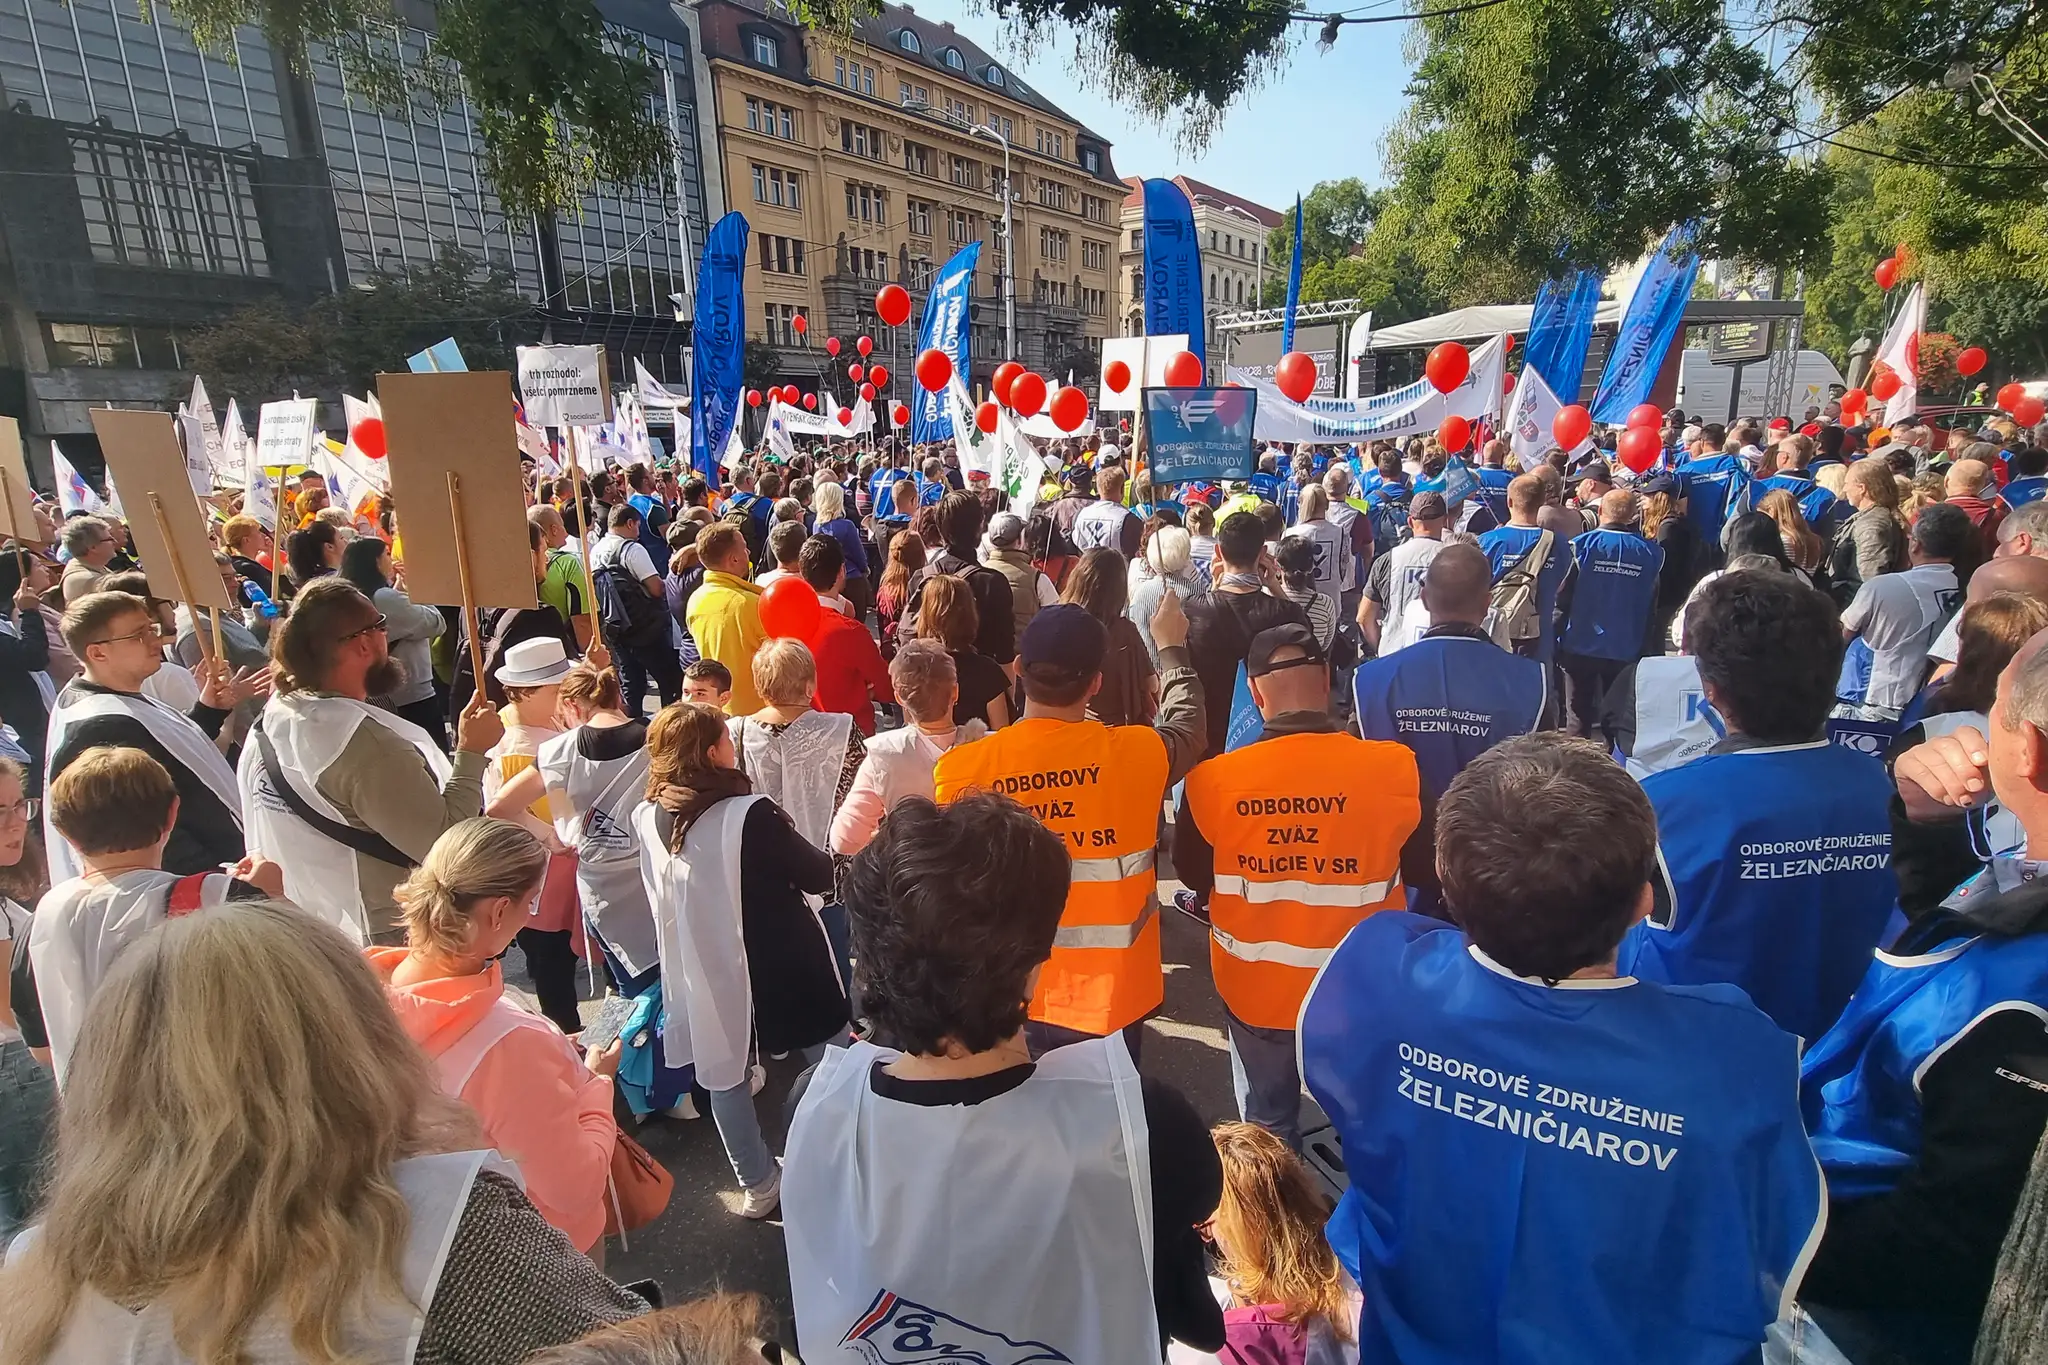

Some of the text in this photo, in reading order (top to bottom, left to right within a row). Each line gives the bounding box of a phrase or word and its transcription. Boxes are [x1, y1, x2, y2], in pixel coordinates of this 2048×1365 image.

[529, 366, 582, 379] trh rozhodol:
[548, 385, 598, 399] pomrzneme
[1395, 706, 1492, 723] ODBOROVÉ RUŽENIE
[1398, 719, 1490, 738] ŽELEZNIAROV
[992, 763, 1100, 795] ODBOROVÝ
[1236, 792, 1347, 817] ODBOROVÝ
[1072, 831, 1085, 847] V
[1091, 828, 1117, 847] SR
[1266, 824, 1319, 845] ZVÄZ
[1740, 833, 1892, 856] ODBOROVÉ ZDRUŽENIE
[1237, 854, 1359, 874] POLÍCIE V SR
[1740, 853, 1890, 880] ŽELEZNČIAROV
[1398, 1042, 1685, 1136] ODBOROVÉ ZDRUŽENIE
[1397, 1065, 1679, 1172] ŽELEZNIČIAROV
